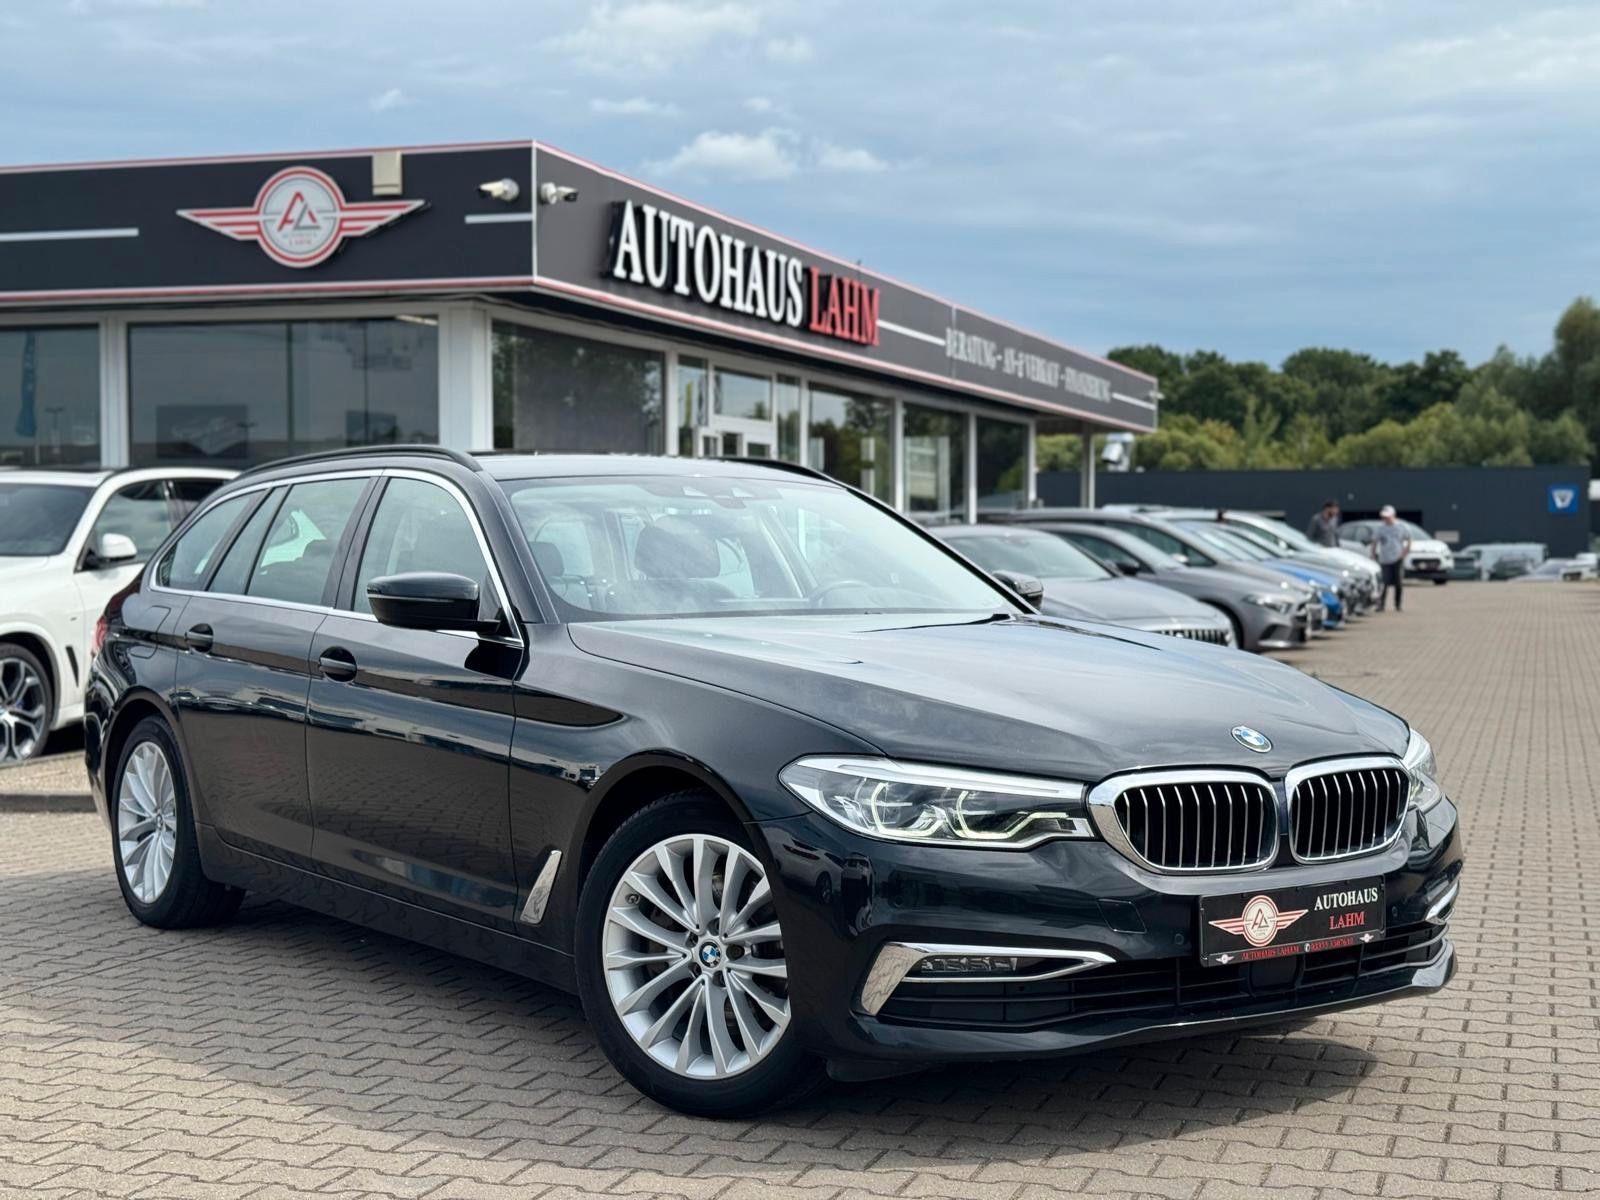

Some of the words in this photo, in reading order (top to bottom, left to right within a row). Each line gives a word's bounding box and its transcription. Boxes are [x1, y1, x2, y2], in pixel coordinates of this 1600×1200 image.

[613, 199, 803, 328] AUTOHAUS
[809, 266, 880, 346] LAHM
[1314, 887, 1378, 911] AUTOHAUS
[1329, 911, 1365, 930] LAHM
